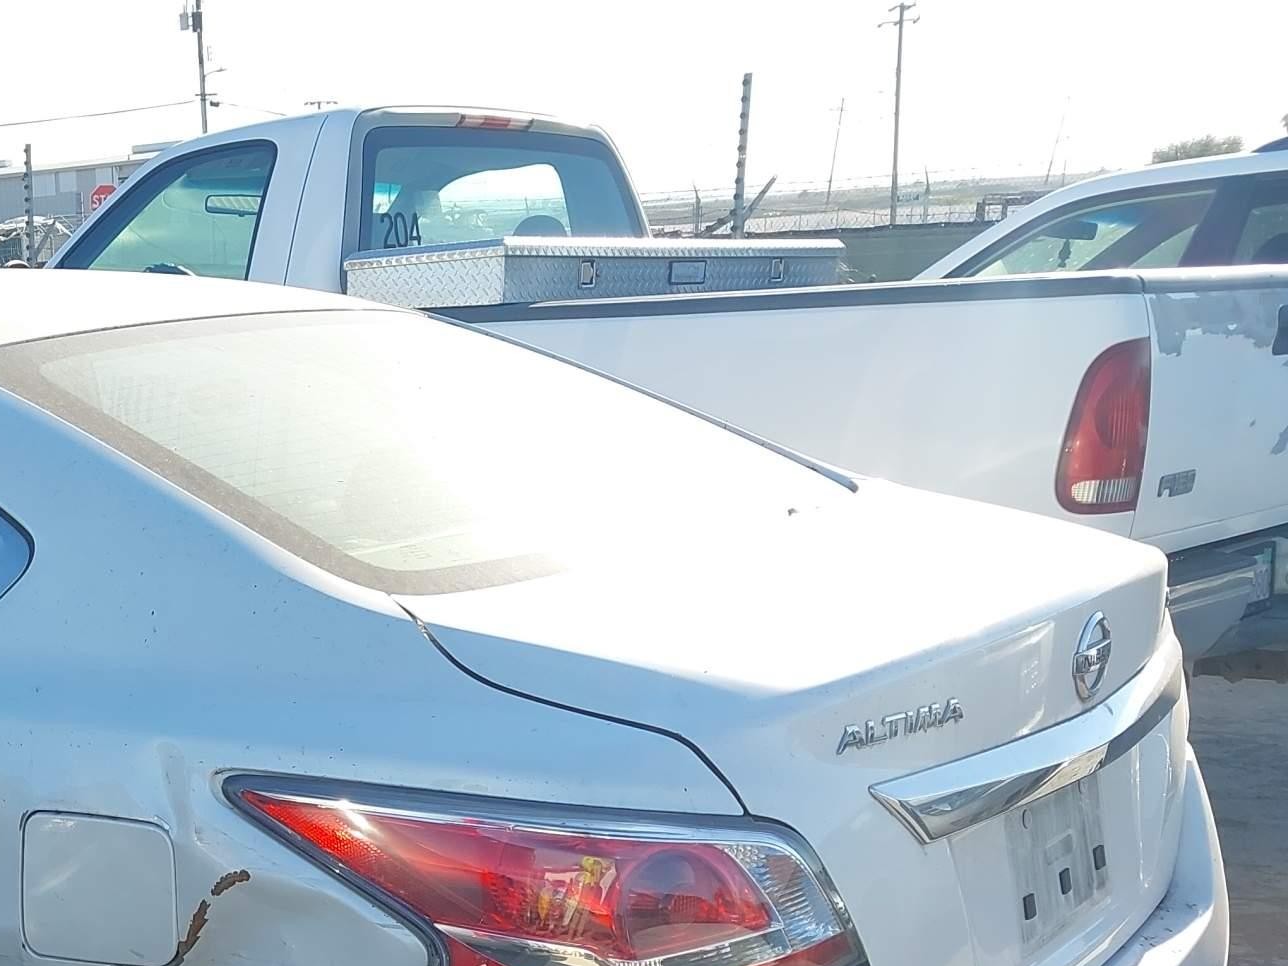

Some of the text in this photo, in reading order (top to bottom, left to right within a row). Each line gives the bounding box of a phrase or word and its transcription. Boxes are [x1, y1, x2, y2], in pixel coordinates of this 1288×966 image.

[92, 193, 108, 209] ST
[380, 211, 422, 249] 204
[836, 697, 964, 755] ALTIMA
